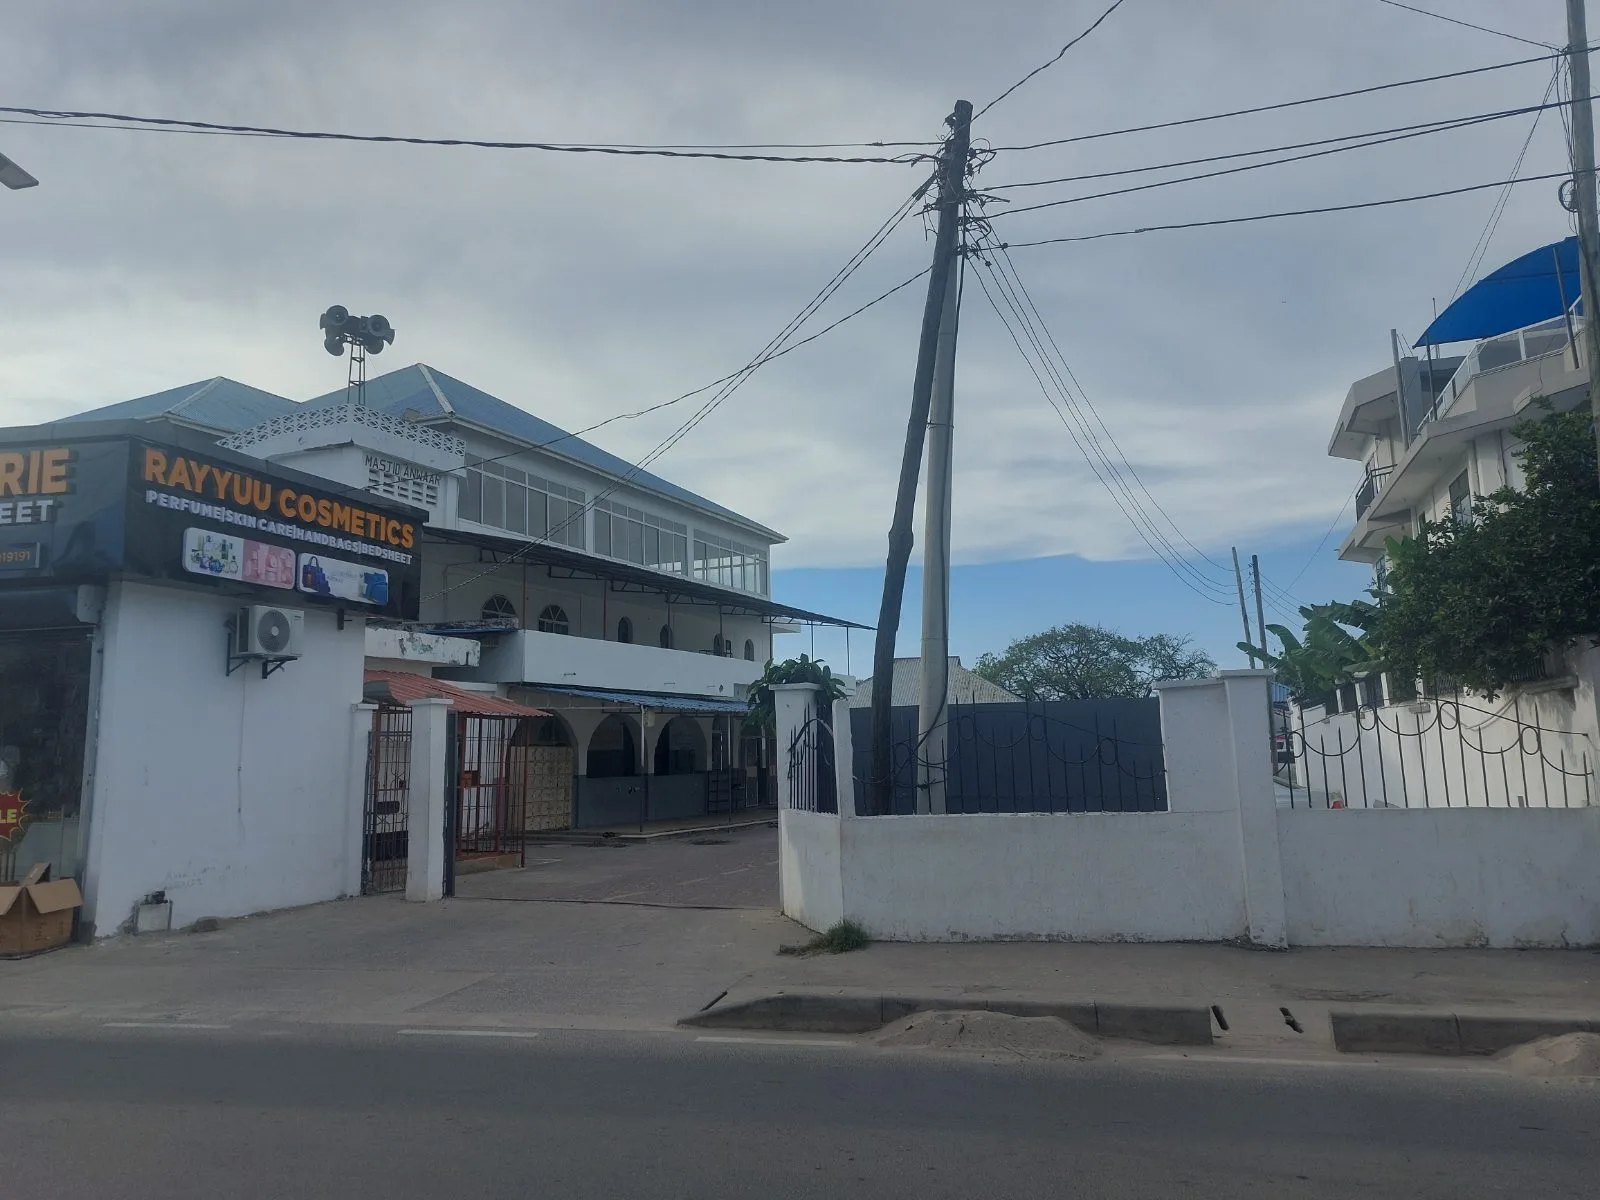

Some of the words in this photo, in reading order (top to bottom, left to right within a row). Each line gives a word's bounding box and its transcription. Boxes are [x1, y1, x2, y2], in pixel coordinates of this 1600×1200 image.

[0, 448, 70, 496] RIE
[365, 455, 401, 475] MASJID
[404, 464, 442, 486] ANWAAR
[145, 447, 272, 511] RAYYUU
[278, 489, 415, 549] COSMETICS
[0, 551, 30, 563] 19191
